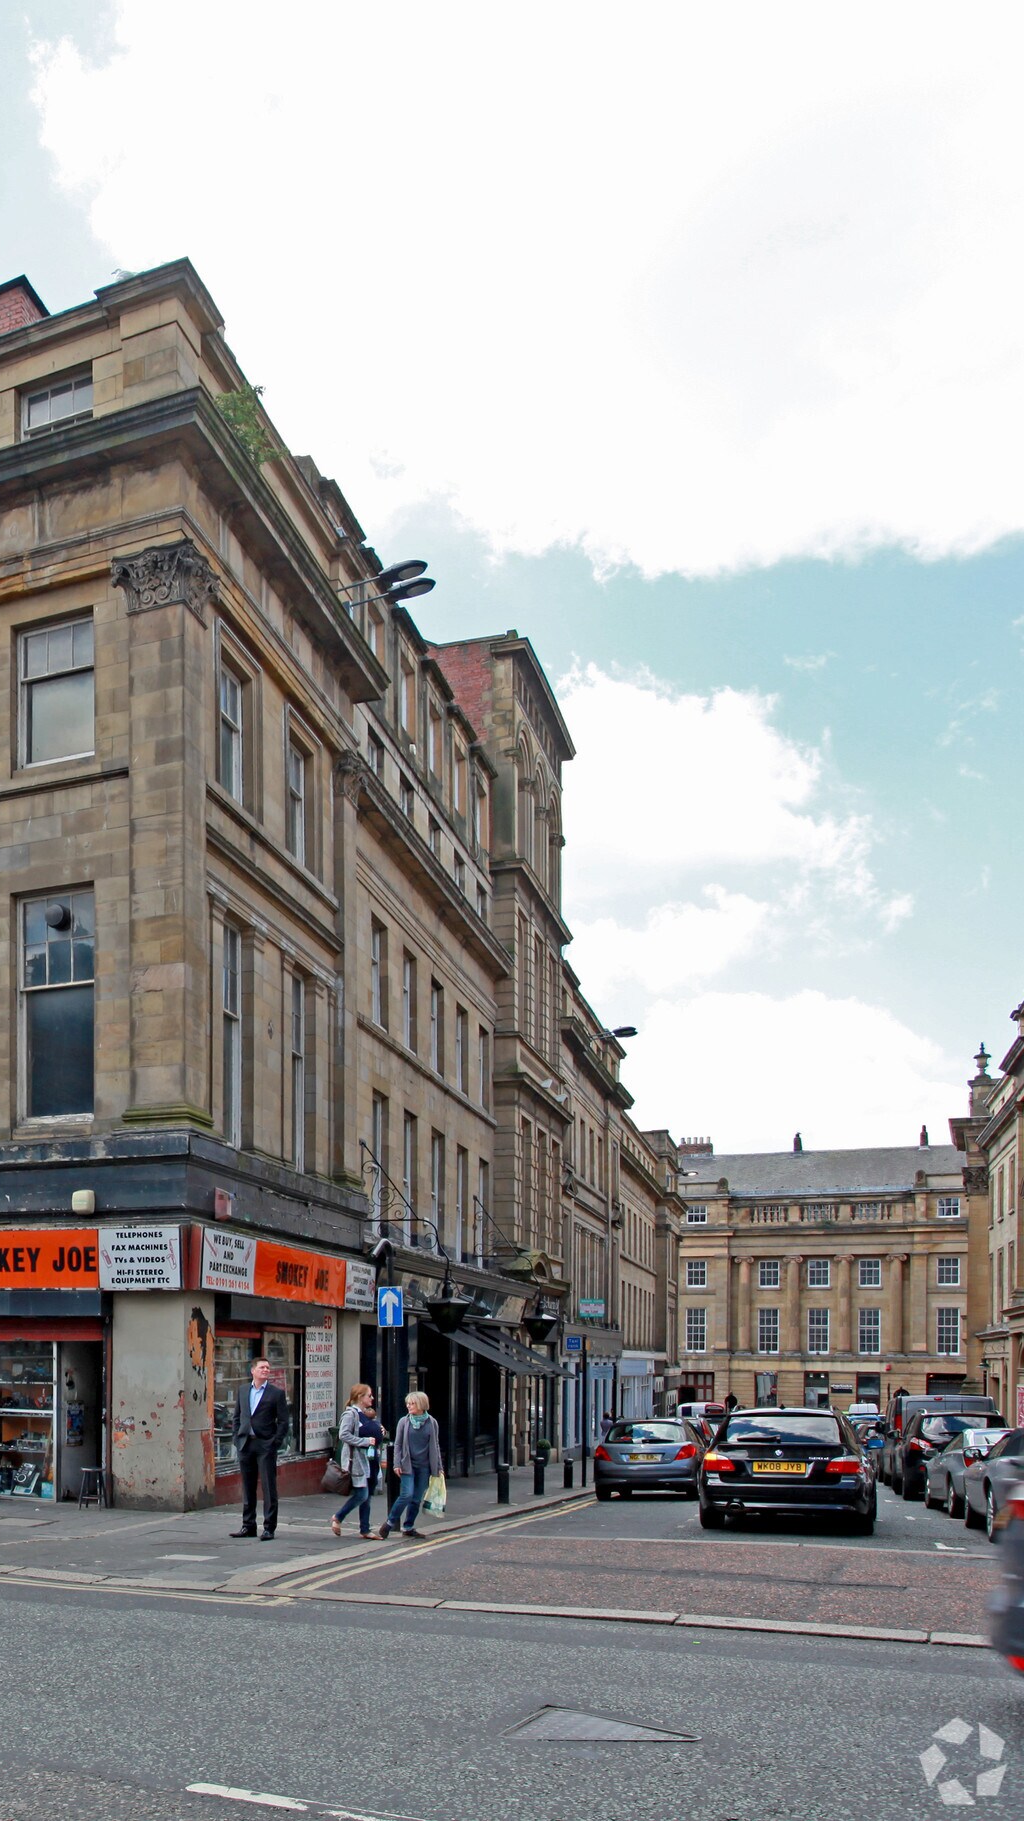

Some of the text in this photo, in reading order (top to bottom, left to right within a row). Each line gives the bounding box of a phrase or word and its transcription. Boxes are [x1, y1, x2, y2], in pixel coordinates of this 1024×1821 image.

[128, 1243, 168, 1251] MACHINES
[213, 1234, 222, 1245] WE
[234, 1239, 245, 1250] SELL
[52, 1246, 97, 1272] JOE
[223, 1251, 234, 1260] AND
[209, 1261, 248, 1277] PART EXCHANGE
[276, 1260, 329, 1291] SMOKEY JOE
[325, 1332, 333, 1342] BUY
[309, 1354, 330, 1363] EXCHANGE
[757, 1462, 802, 1471] WK08 JYB
